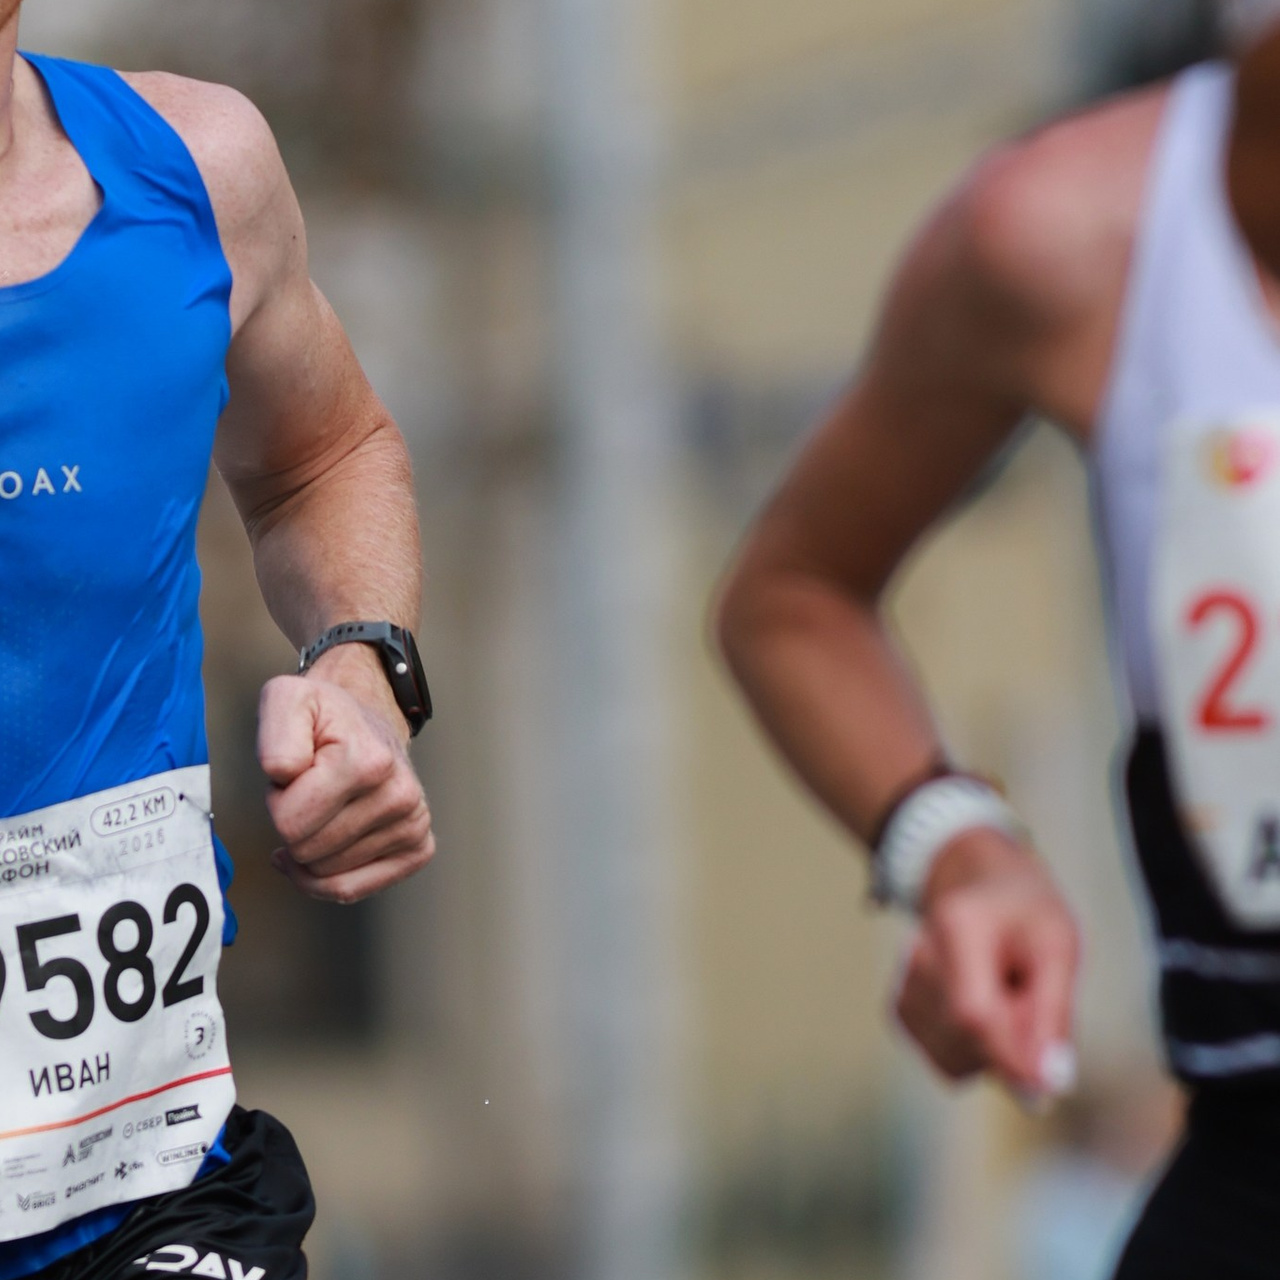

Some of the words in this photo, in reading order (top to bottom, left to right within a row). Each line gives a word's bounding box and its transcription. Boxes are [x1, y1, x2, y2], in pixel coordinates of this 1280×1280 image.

[102, 803, 137, 827] 42,2
[194, 1026, 205, 1046] 3
[30, 1052, 111, 1098] ИВАН
